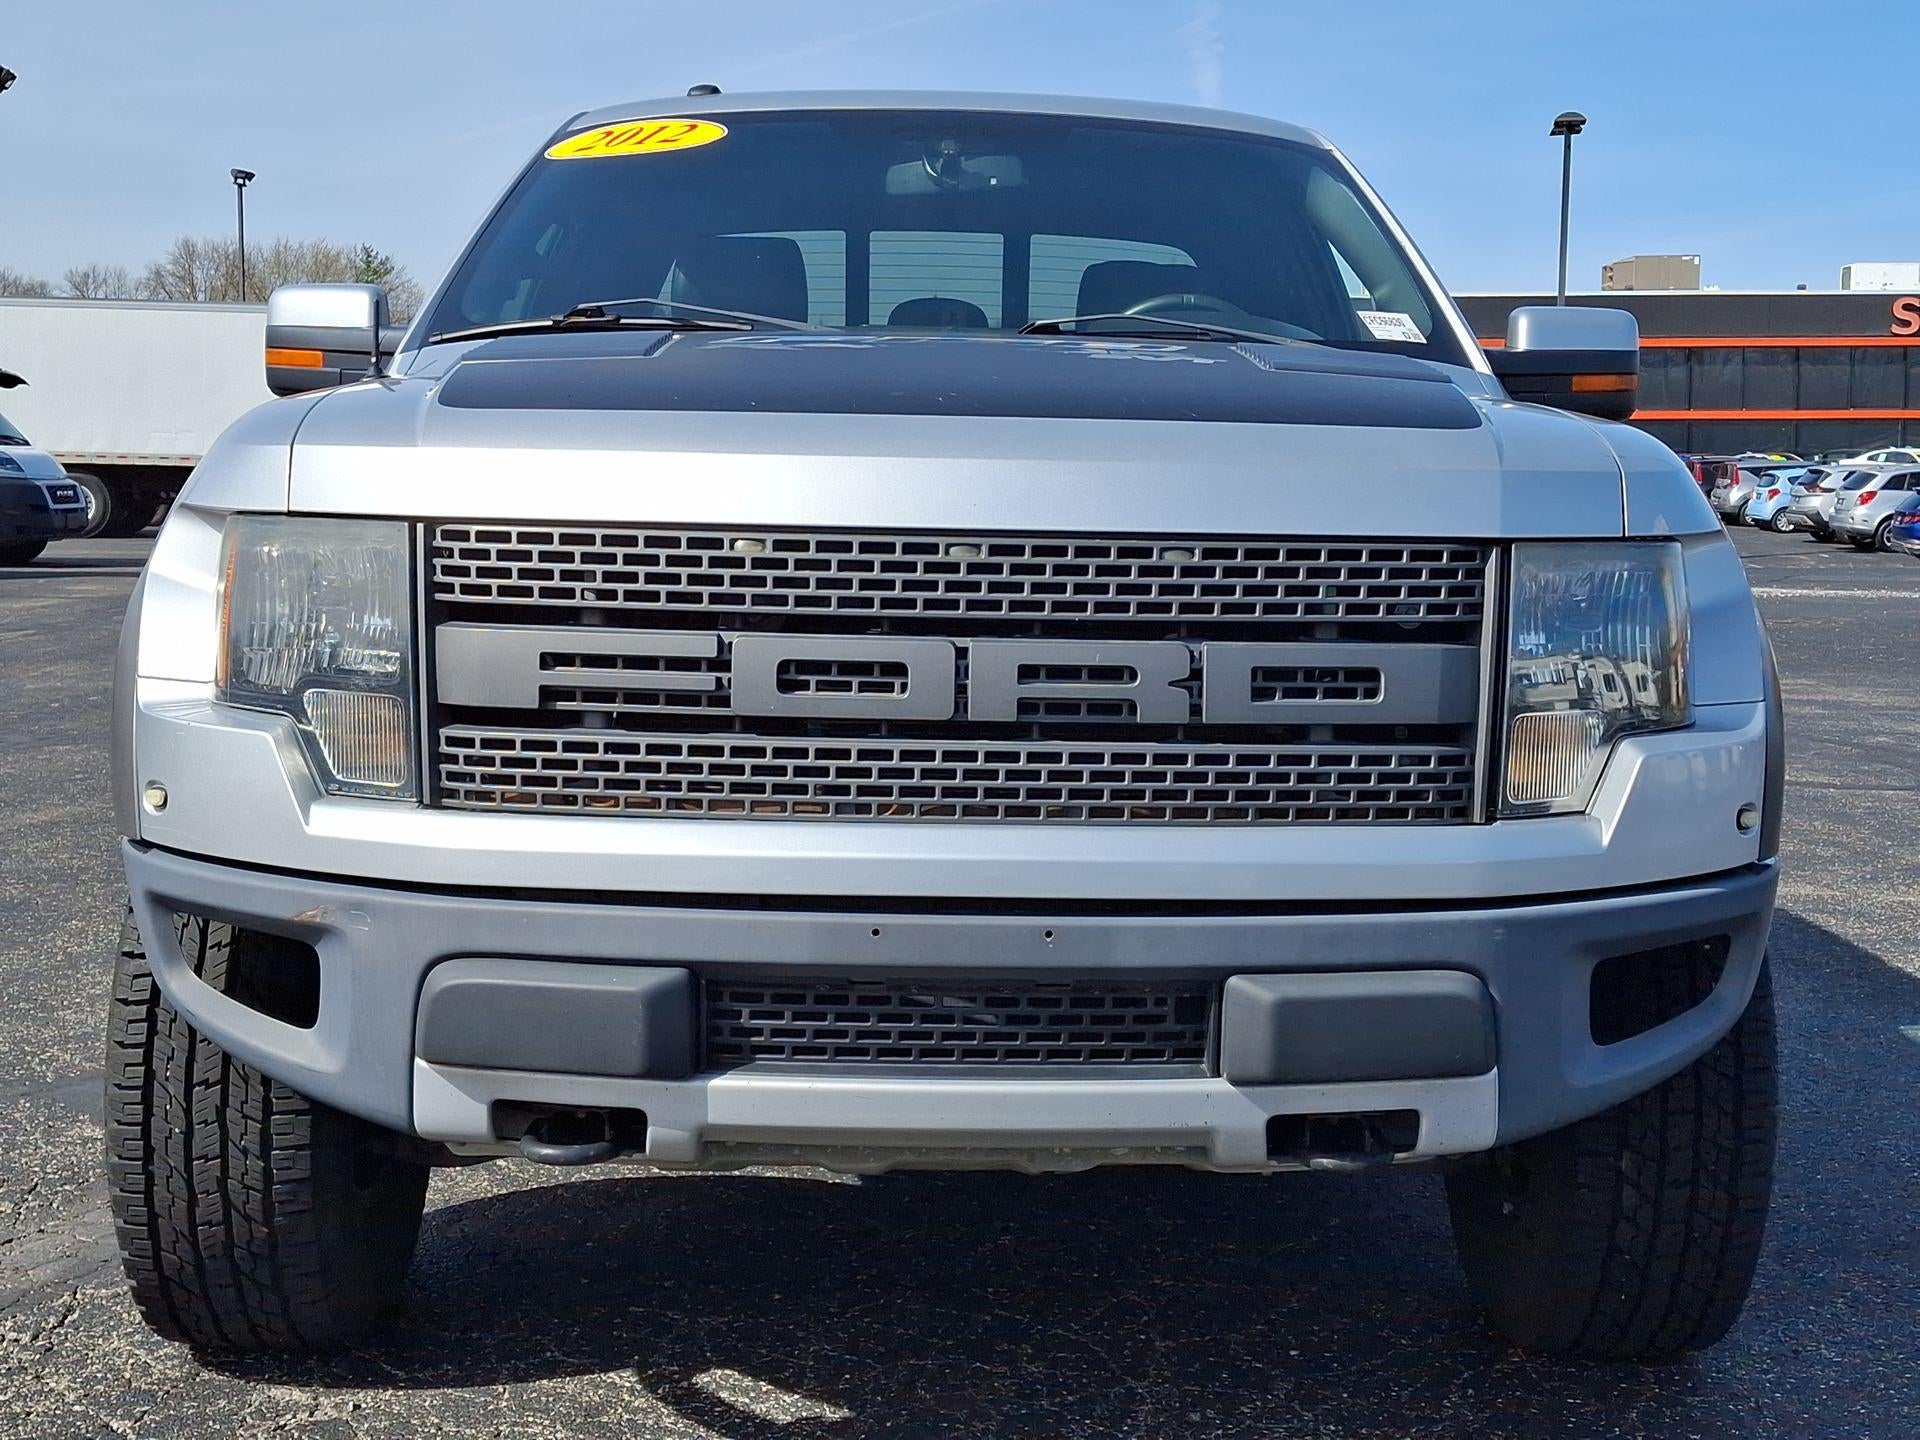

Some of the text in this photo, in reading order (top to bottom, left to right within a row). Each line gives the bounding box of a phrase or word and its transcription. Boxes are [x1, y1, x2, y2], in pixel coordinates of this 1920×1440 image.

[572, 124, 699, 153] 2012
[1891, 297, 1920, 335] S
[435, 622, 1479, 724] FORD
